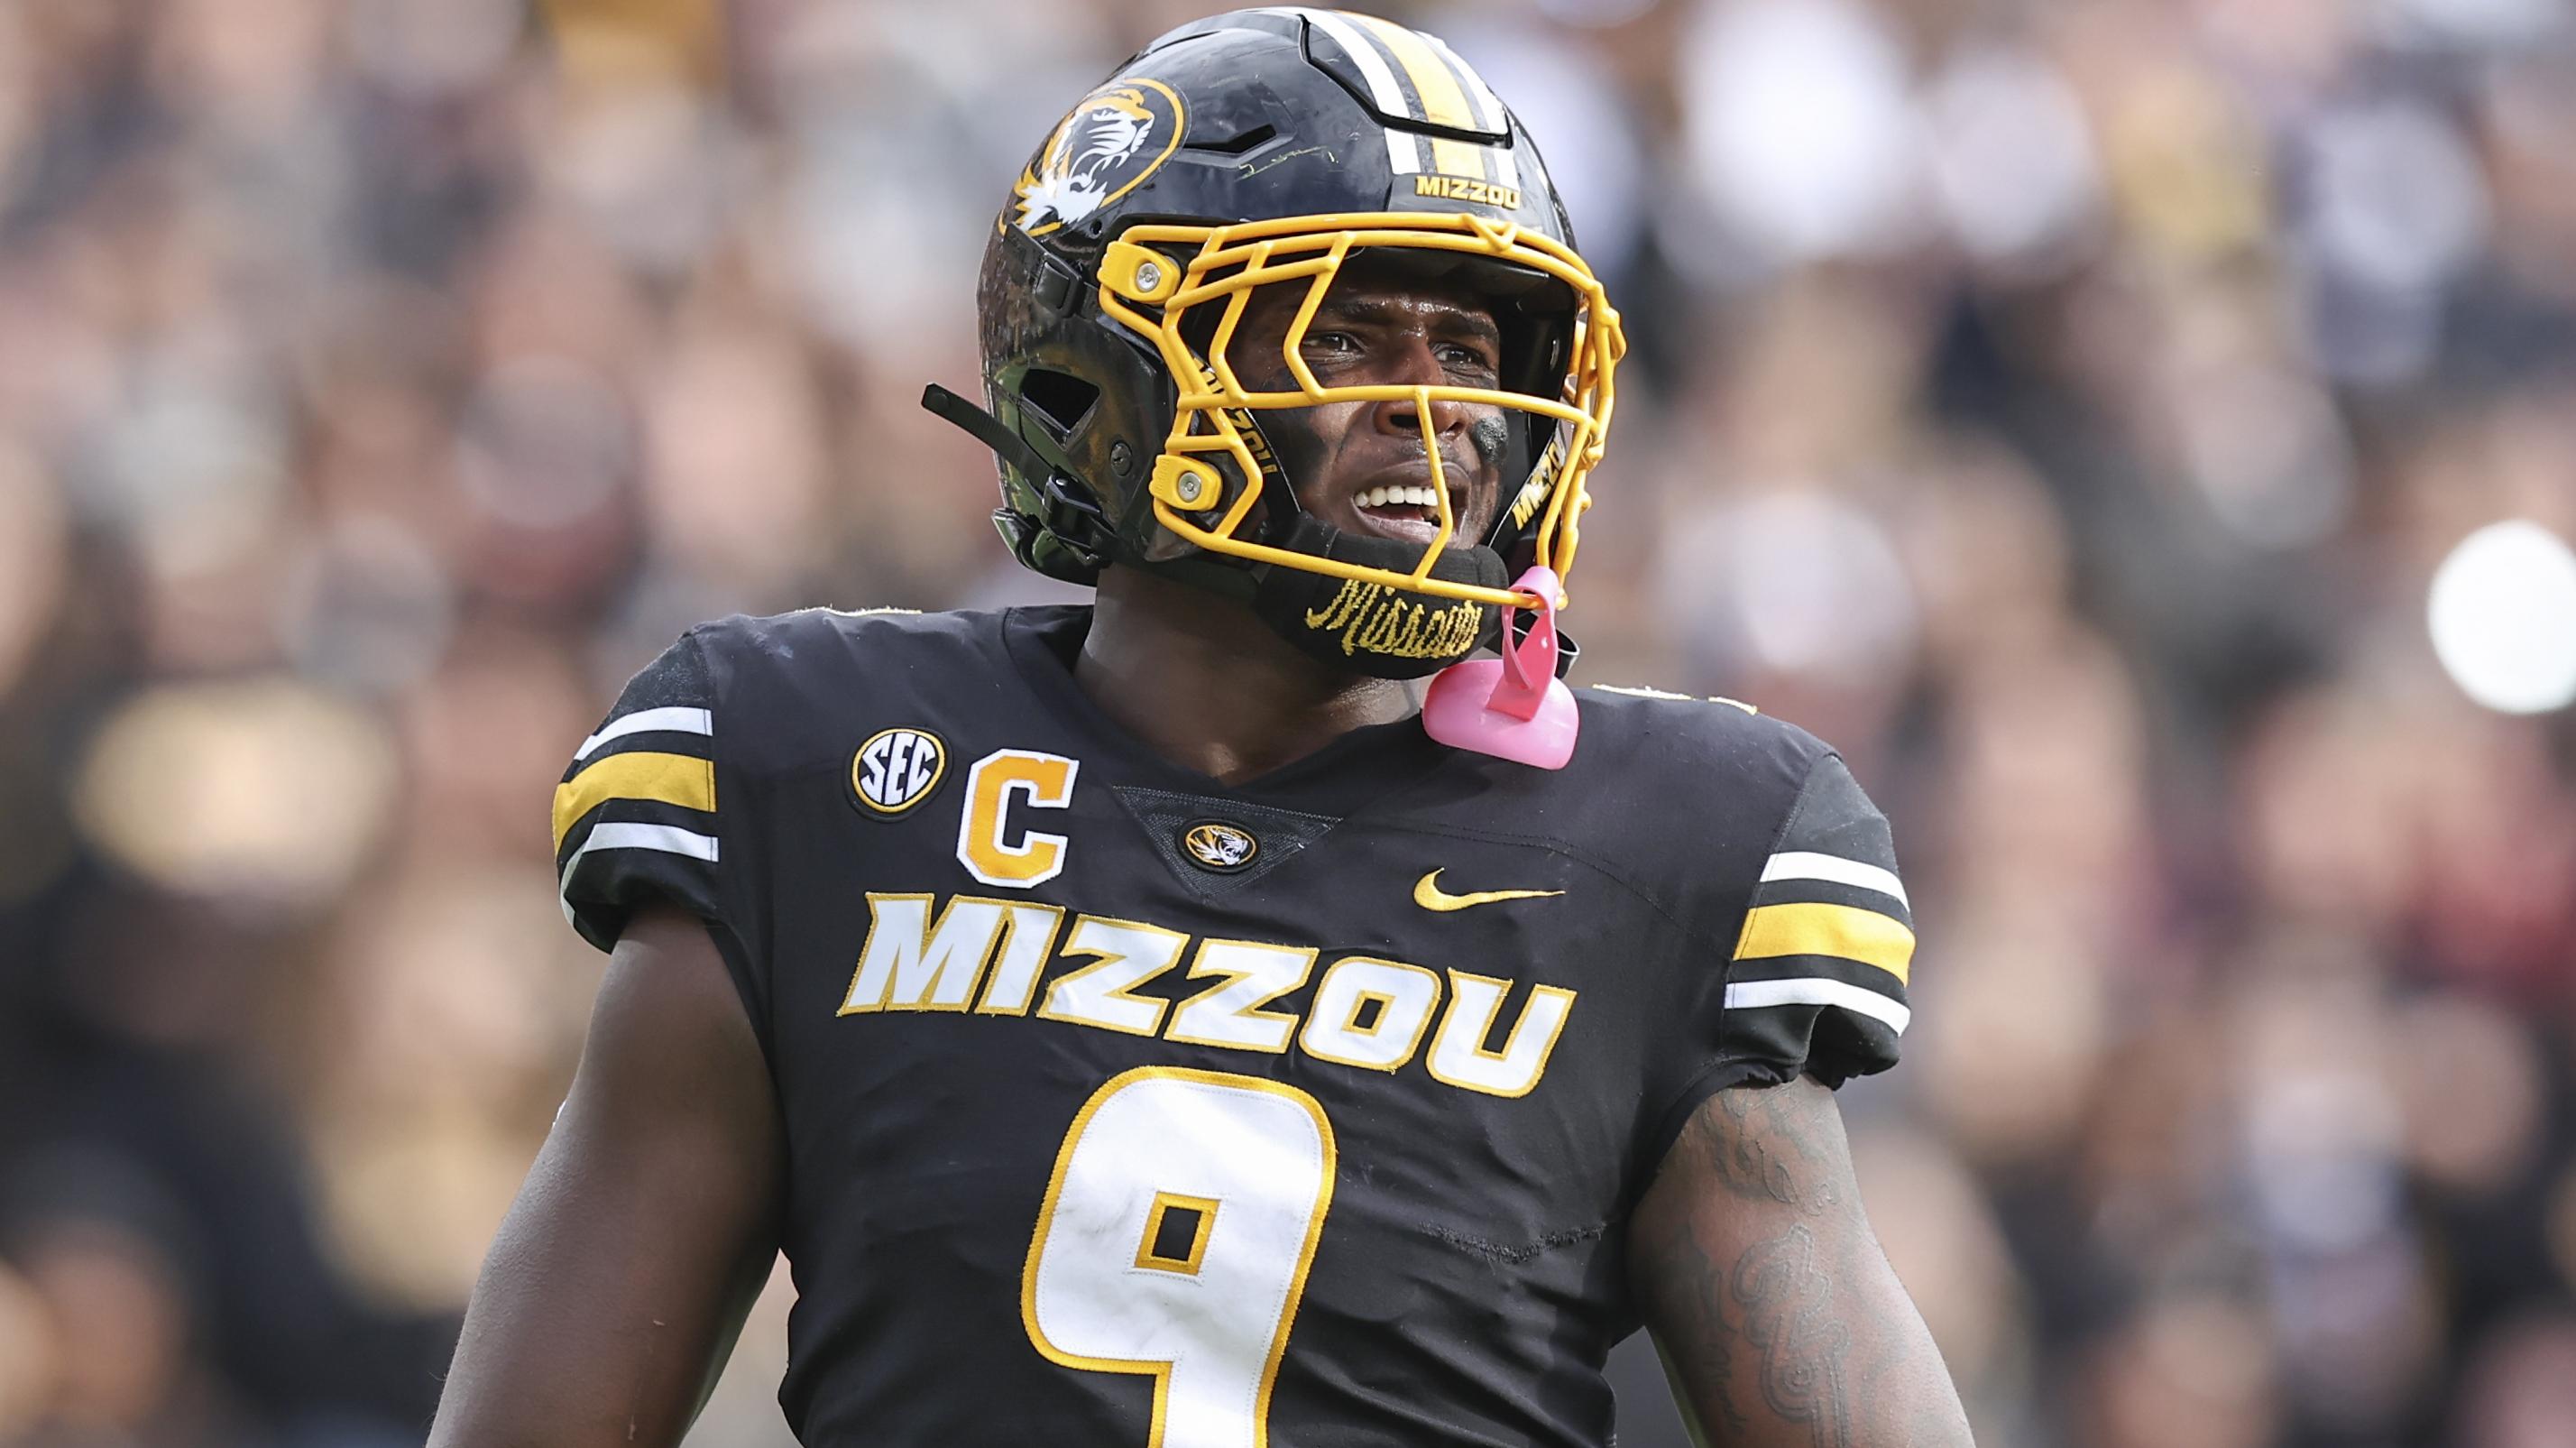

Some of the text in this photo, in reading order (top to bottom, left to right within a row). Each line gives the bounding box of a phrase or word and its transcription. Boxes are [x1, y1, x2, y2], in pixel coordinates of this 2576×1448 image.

[1416, 175, 1521, 209] MIZZOU
[860, 732, 936, 806] SEC
[956, 748, 1081, 889] C
[837, 891, 1577, 1098] MIZZOU
[1021, 1065, 1337, 1448] 9
